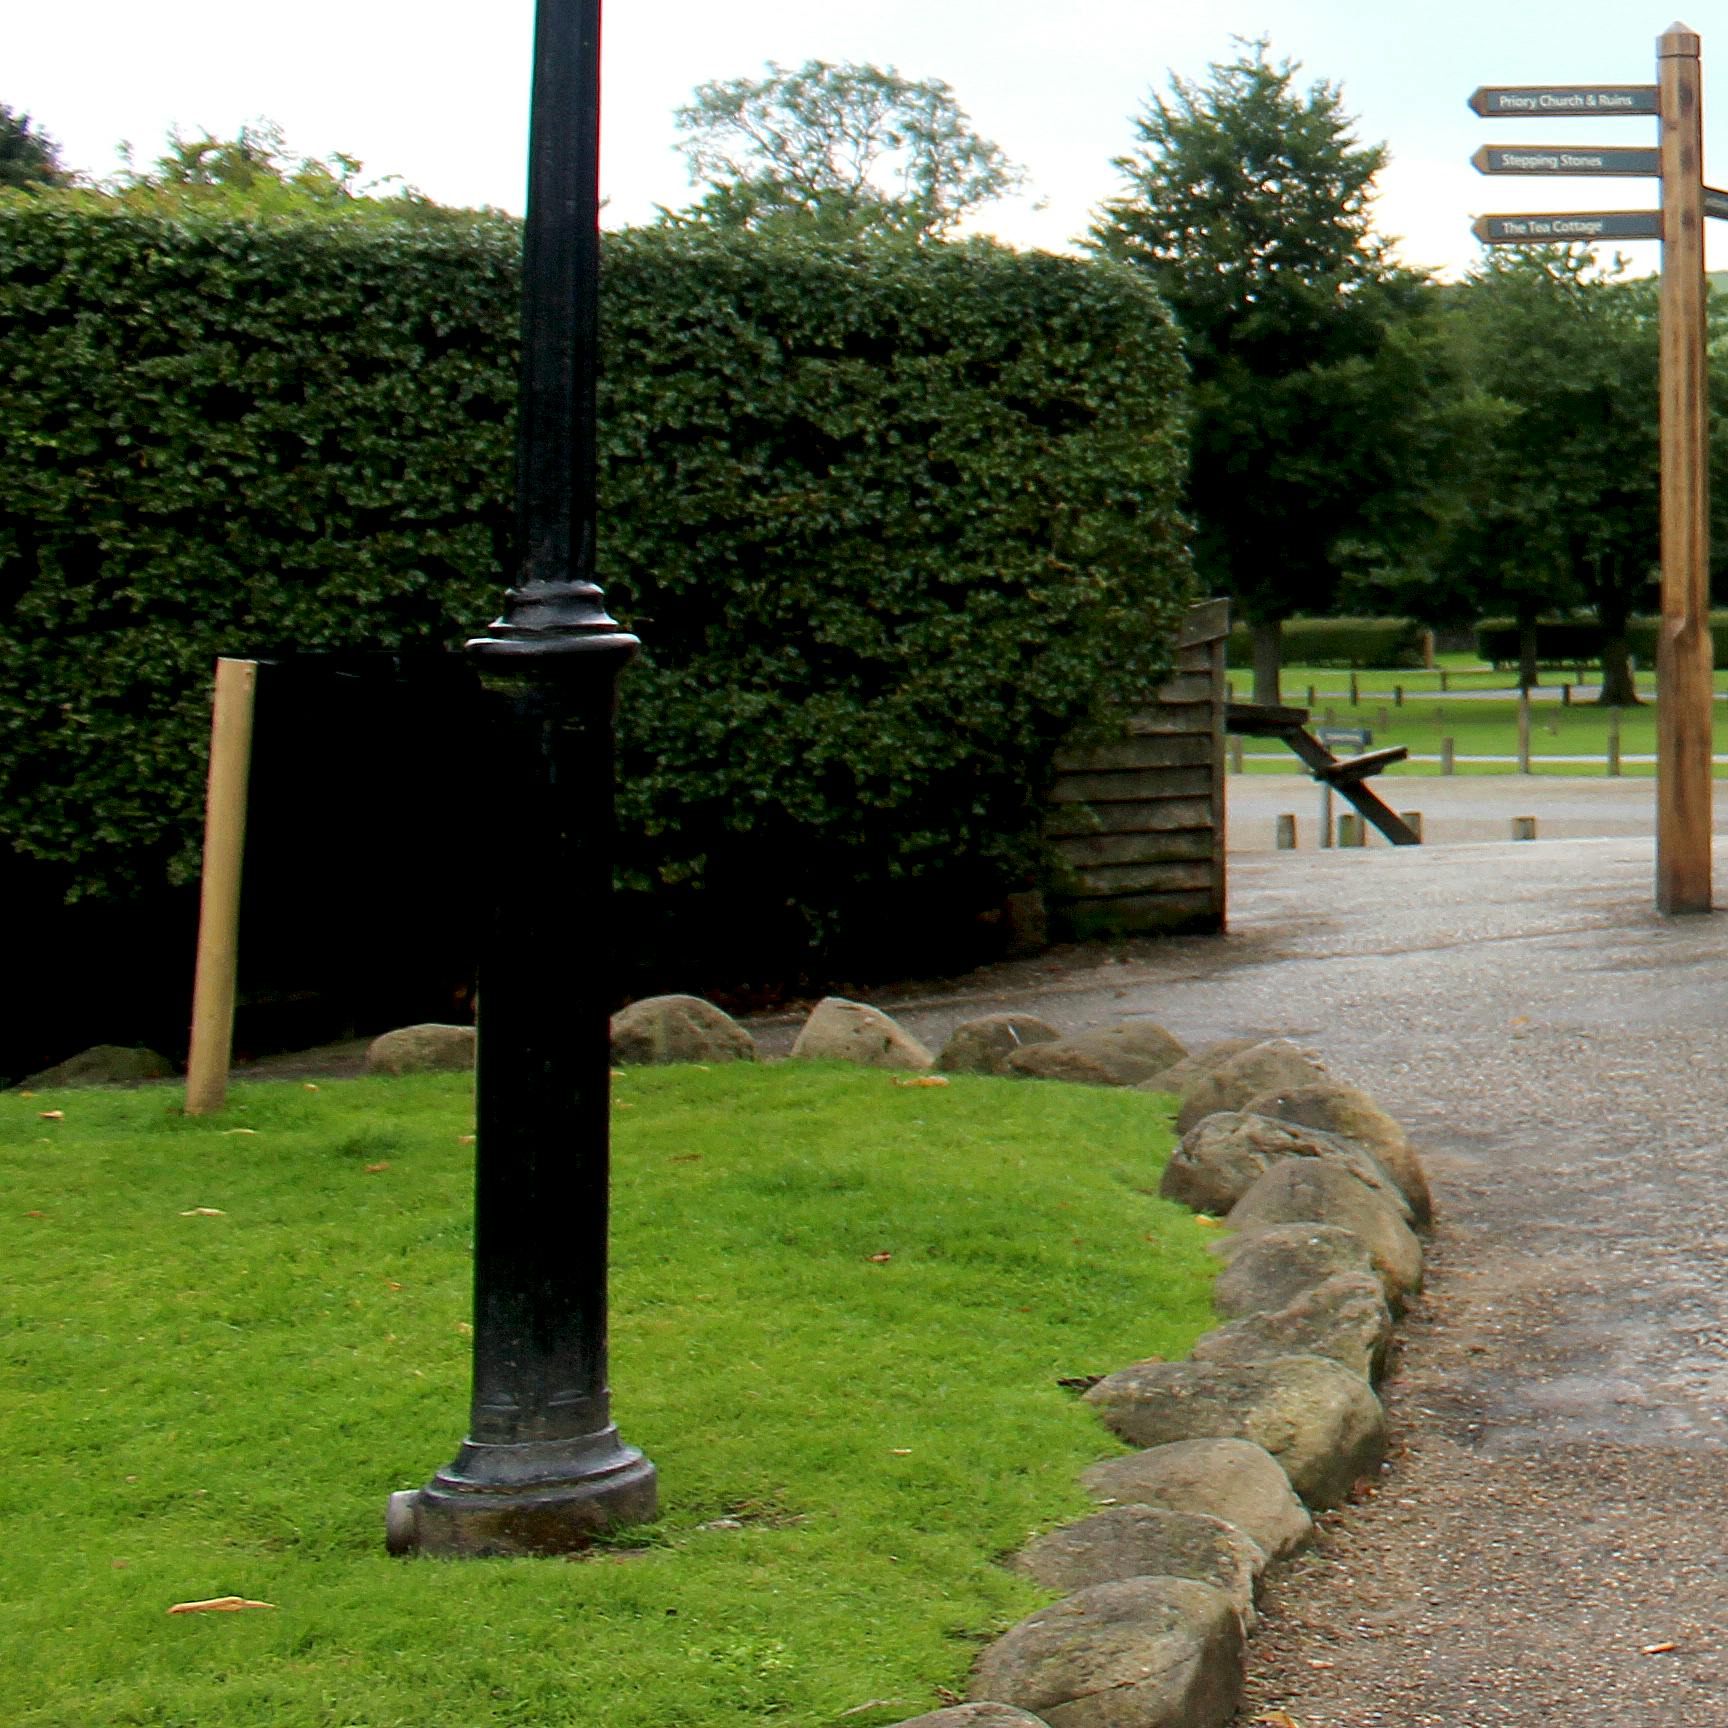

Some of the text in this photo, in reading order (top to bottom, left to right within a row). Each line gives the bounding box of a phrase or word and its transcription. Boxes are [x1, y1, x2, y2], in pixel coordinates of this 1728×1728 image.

[1499, 93, 1632, 109] Priory Church & Ruins
[1501, 154, 1602, 169] Stepping Stones
[1502, 220, 1602, 235] The Tea Cottage
